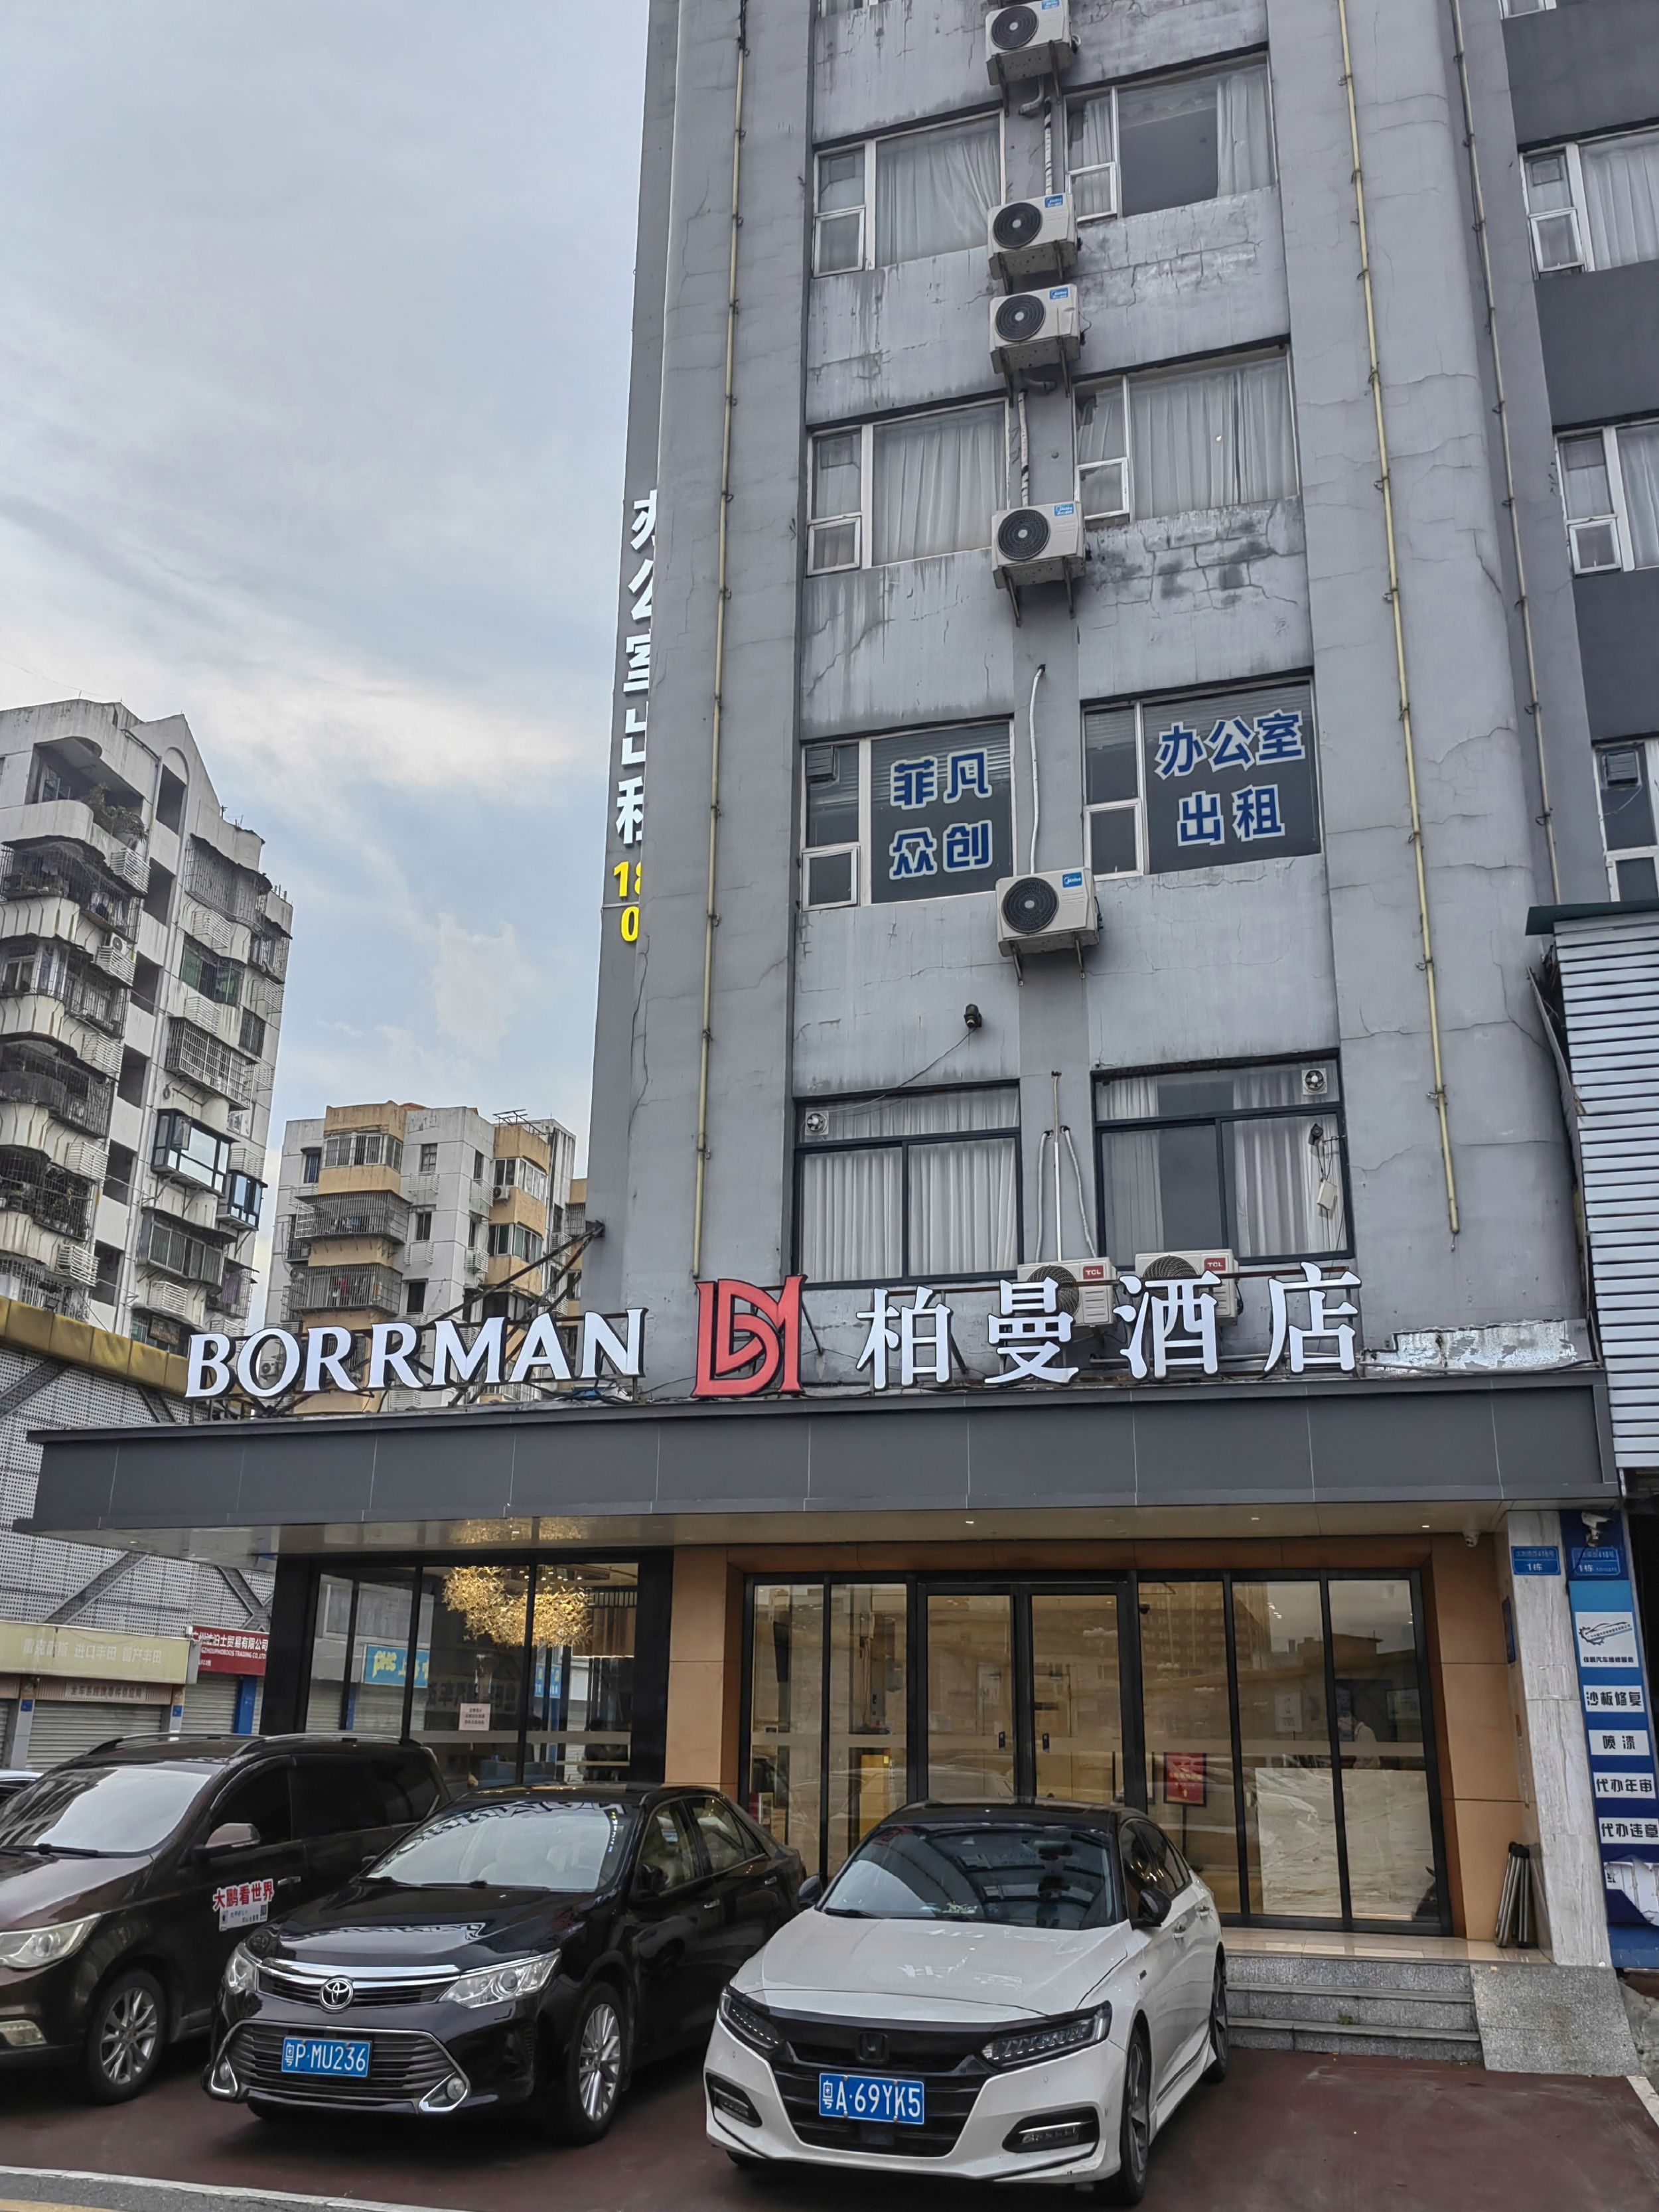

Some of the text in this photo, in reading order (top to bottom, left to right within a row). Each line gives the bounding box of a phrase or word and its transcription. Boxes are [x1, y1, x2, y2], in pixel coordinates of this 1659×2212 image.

[1155, 709, 1305, 779] 办公室
[891, 749, 992, 810] 菲凡
[1177, 784, 1285, 846] 出租
[889, 820, 993, 880] 众创
[185, 1307, 648, 1398] BORRMAN
[855, 1262, 1362, 1391] 柏曼酒店
[74, 1643, 117, 1660] 进口丰田
[122, 1647, 161, 1663] 国产丰田
[1603, 1735, 1635, 1749] 喷漆
[1596, 1779, 1652, 1793] 代办年审
[1601, 1823, 1658, 1838] 代办违章
[213, 1880, 273, 1910] 大鹏看世界
